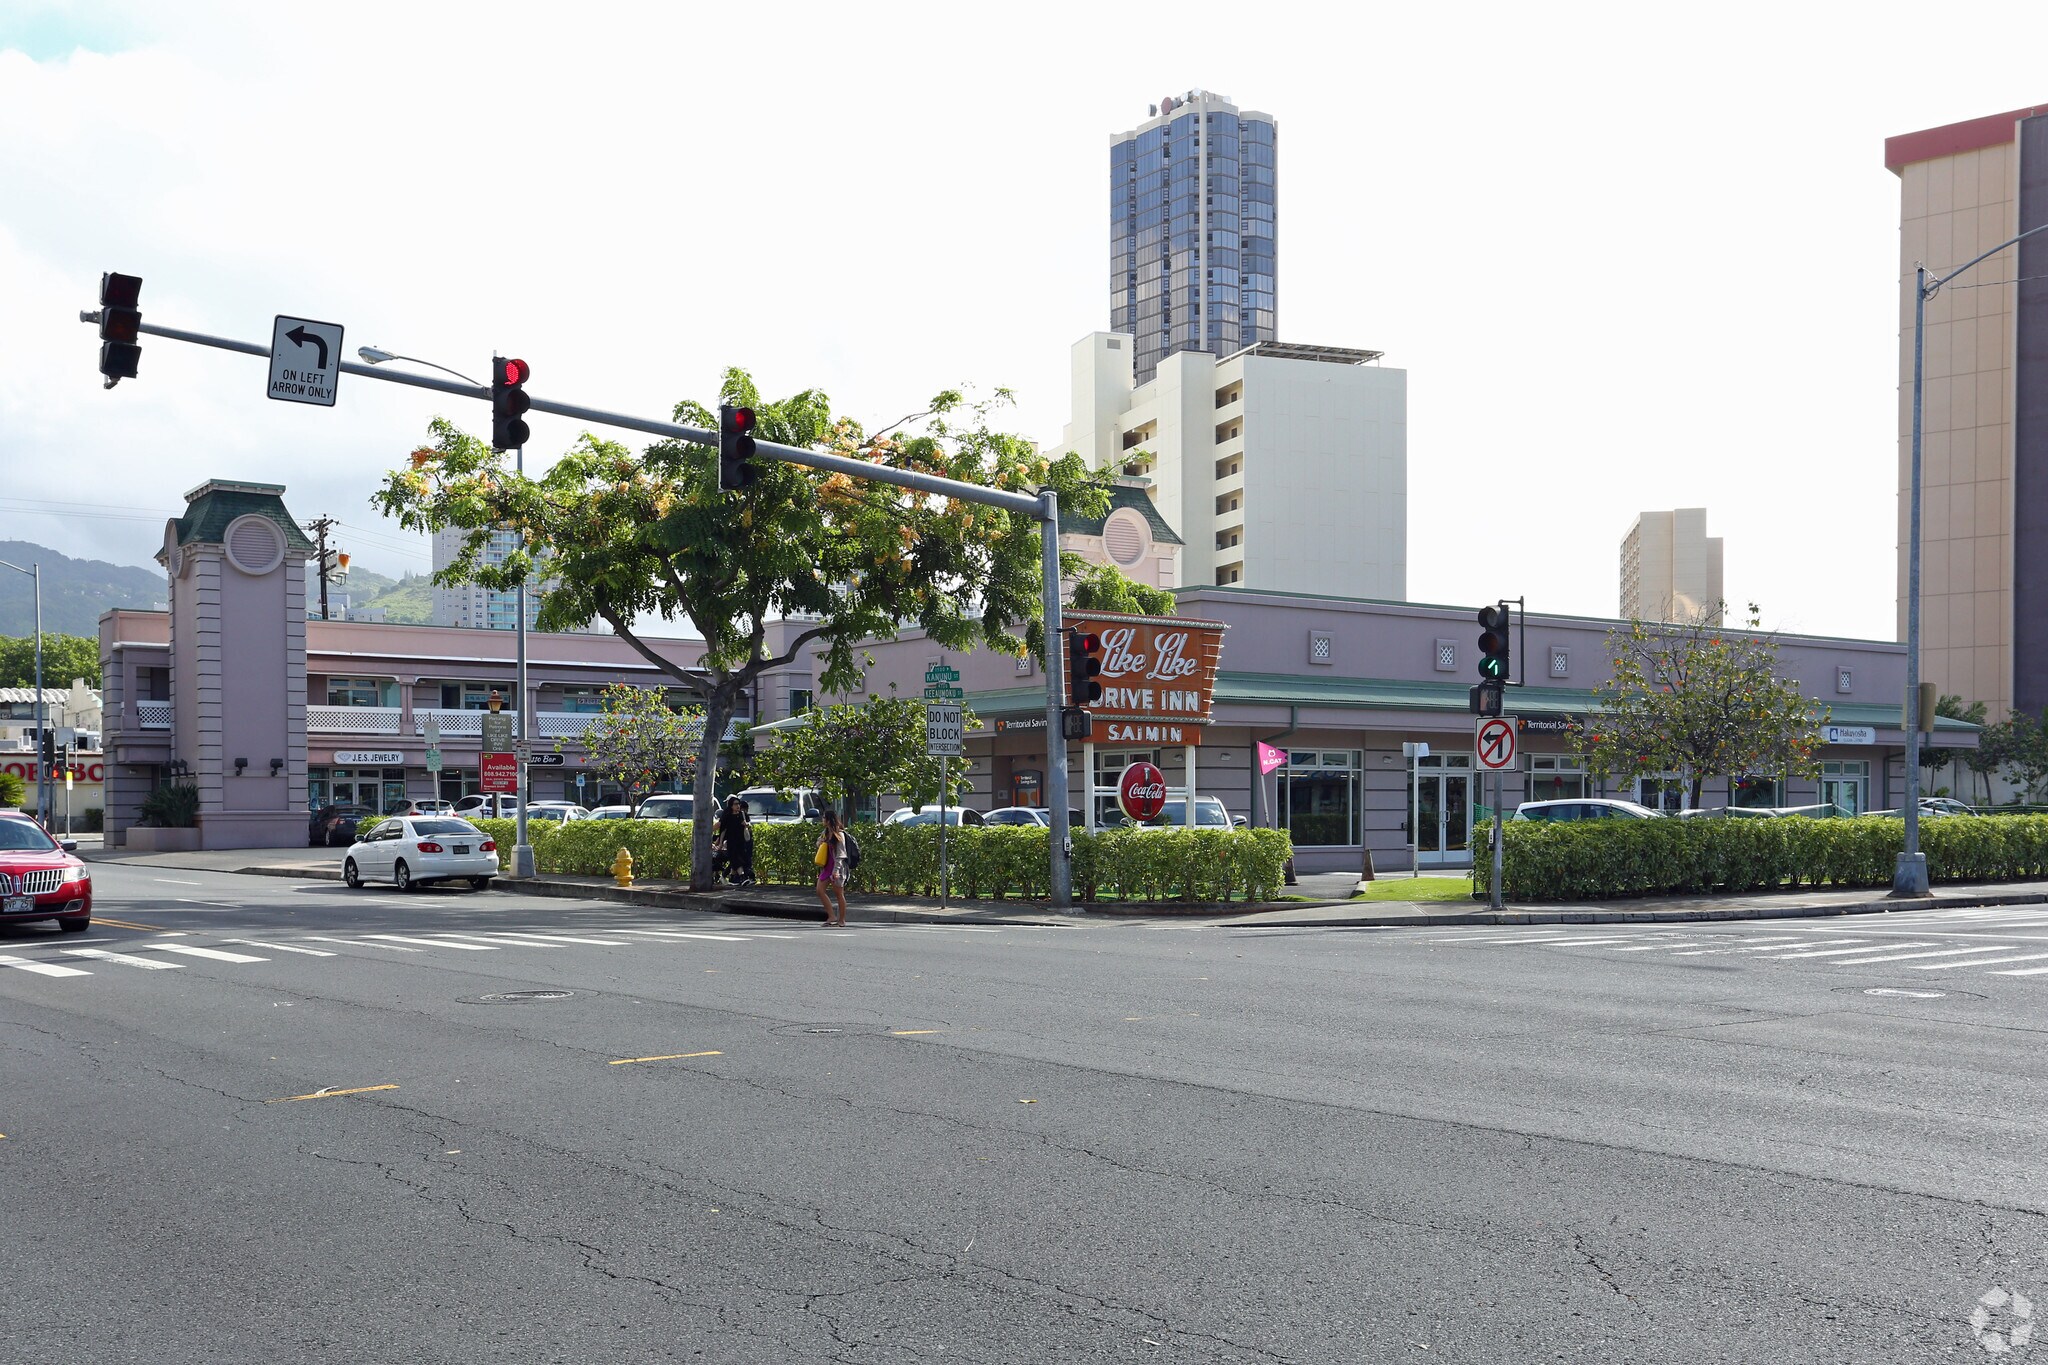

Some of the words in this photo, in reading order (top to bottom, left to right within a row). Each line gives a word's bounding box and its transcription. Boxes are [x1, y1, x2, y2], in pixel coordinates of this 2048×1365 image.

[283, 369, 297, 381] ON
[300, 372, 325, 385] LEFT
[272, 381, 306, 396] ARROW
[308, 386, 332, 399] ONLY
[1100, 628, 1146, 678] Like
[1146, 633, 1200, 680] Like
[926, 672, 952, 681] KANUNU
[1161, 689, 1200, 712] INN
[929, 711, 941, 723] DO
[943, 711, 960, 723] NOT
[1005, 719, 1031, 729] Territorial
[1031, 718, 1048, 728] Savin
[1527, 720, 1557, 729] Territorial
[929, 728, 960, 740] BLOCK
[1108, 724, 1182, 742] SAIMIN
[928, 743, 960, 752] INTERSECTION
[352, 753, 369, 762] J.E.S.
[370, 753, 400, 762] JEWELRY
[542, 755, 557, 763] Bar
